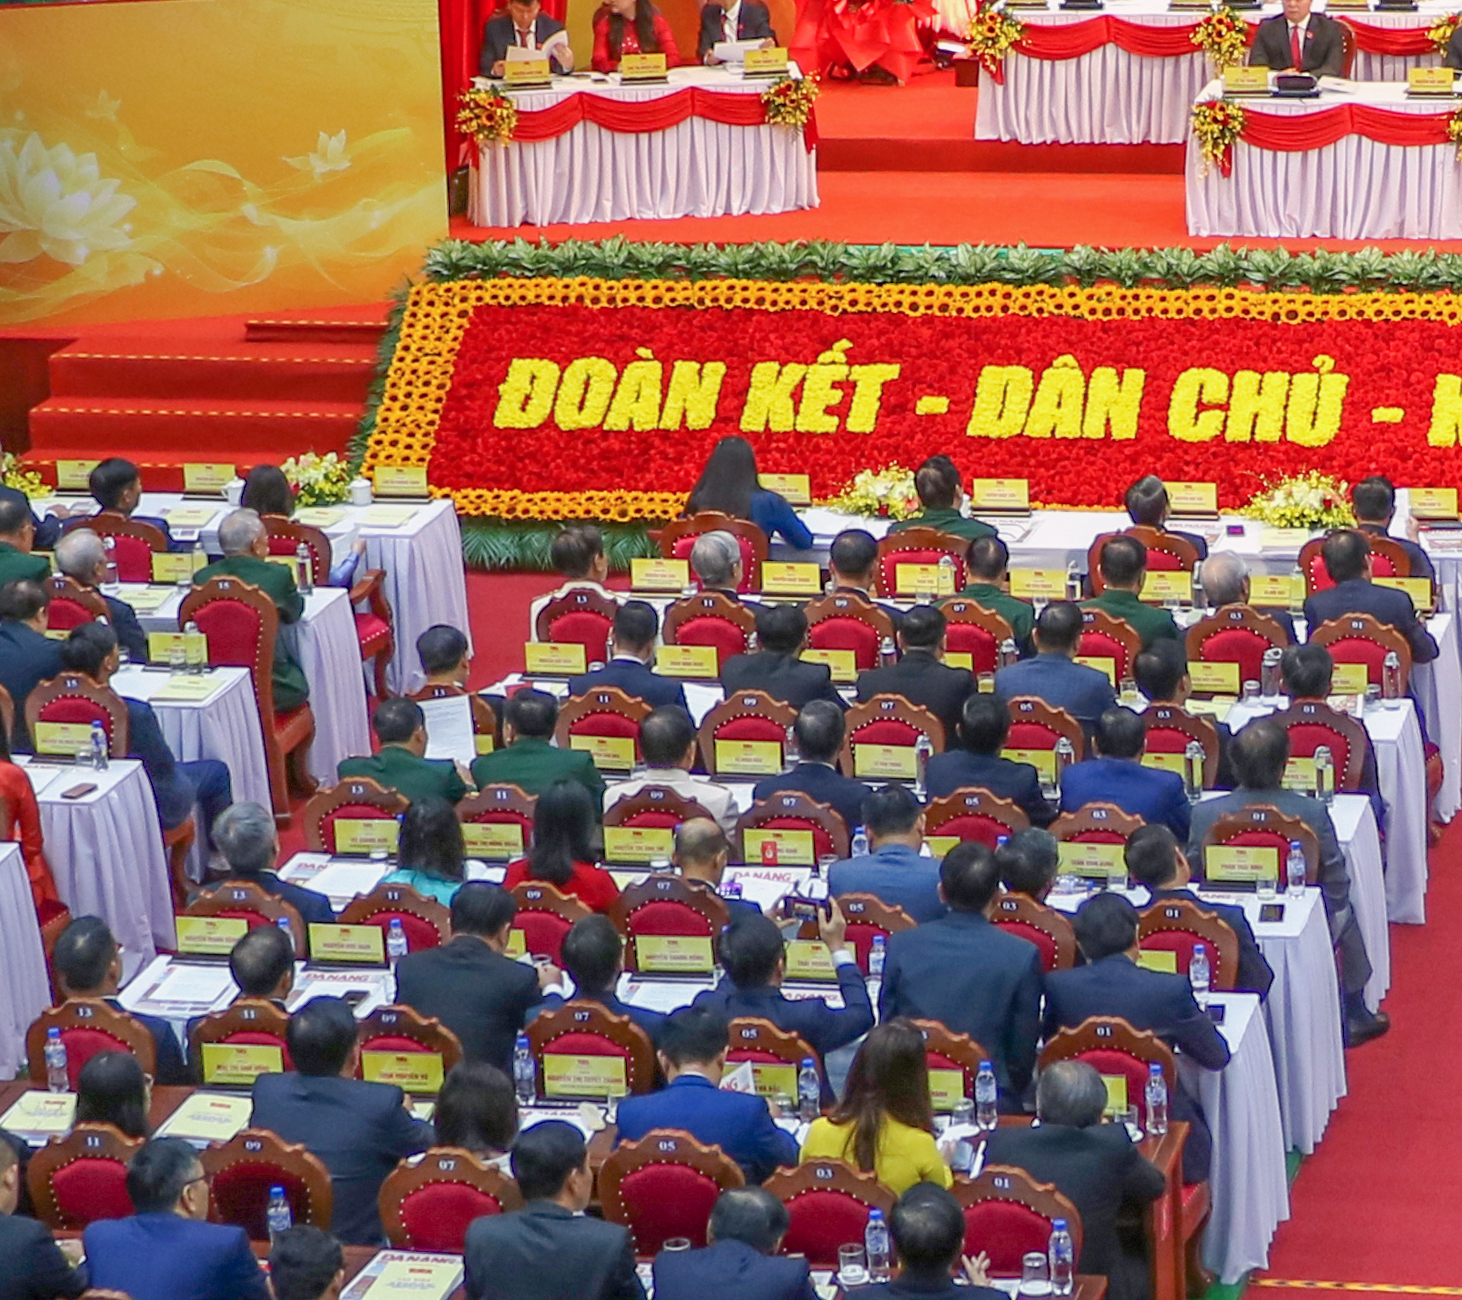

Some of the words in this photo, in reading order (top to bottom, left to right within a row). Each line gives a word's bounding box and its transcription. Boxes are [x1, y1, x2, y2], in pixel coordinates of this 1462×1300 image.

[493, 347, 726, 431] ĐOÀN
[740, 339, 900, 433] KẾT
[967, 354, 1146, 440] DÂN
[1168, 355, 1350, 447] CHỦ
